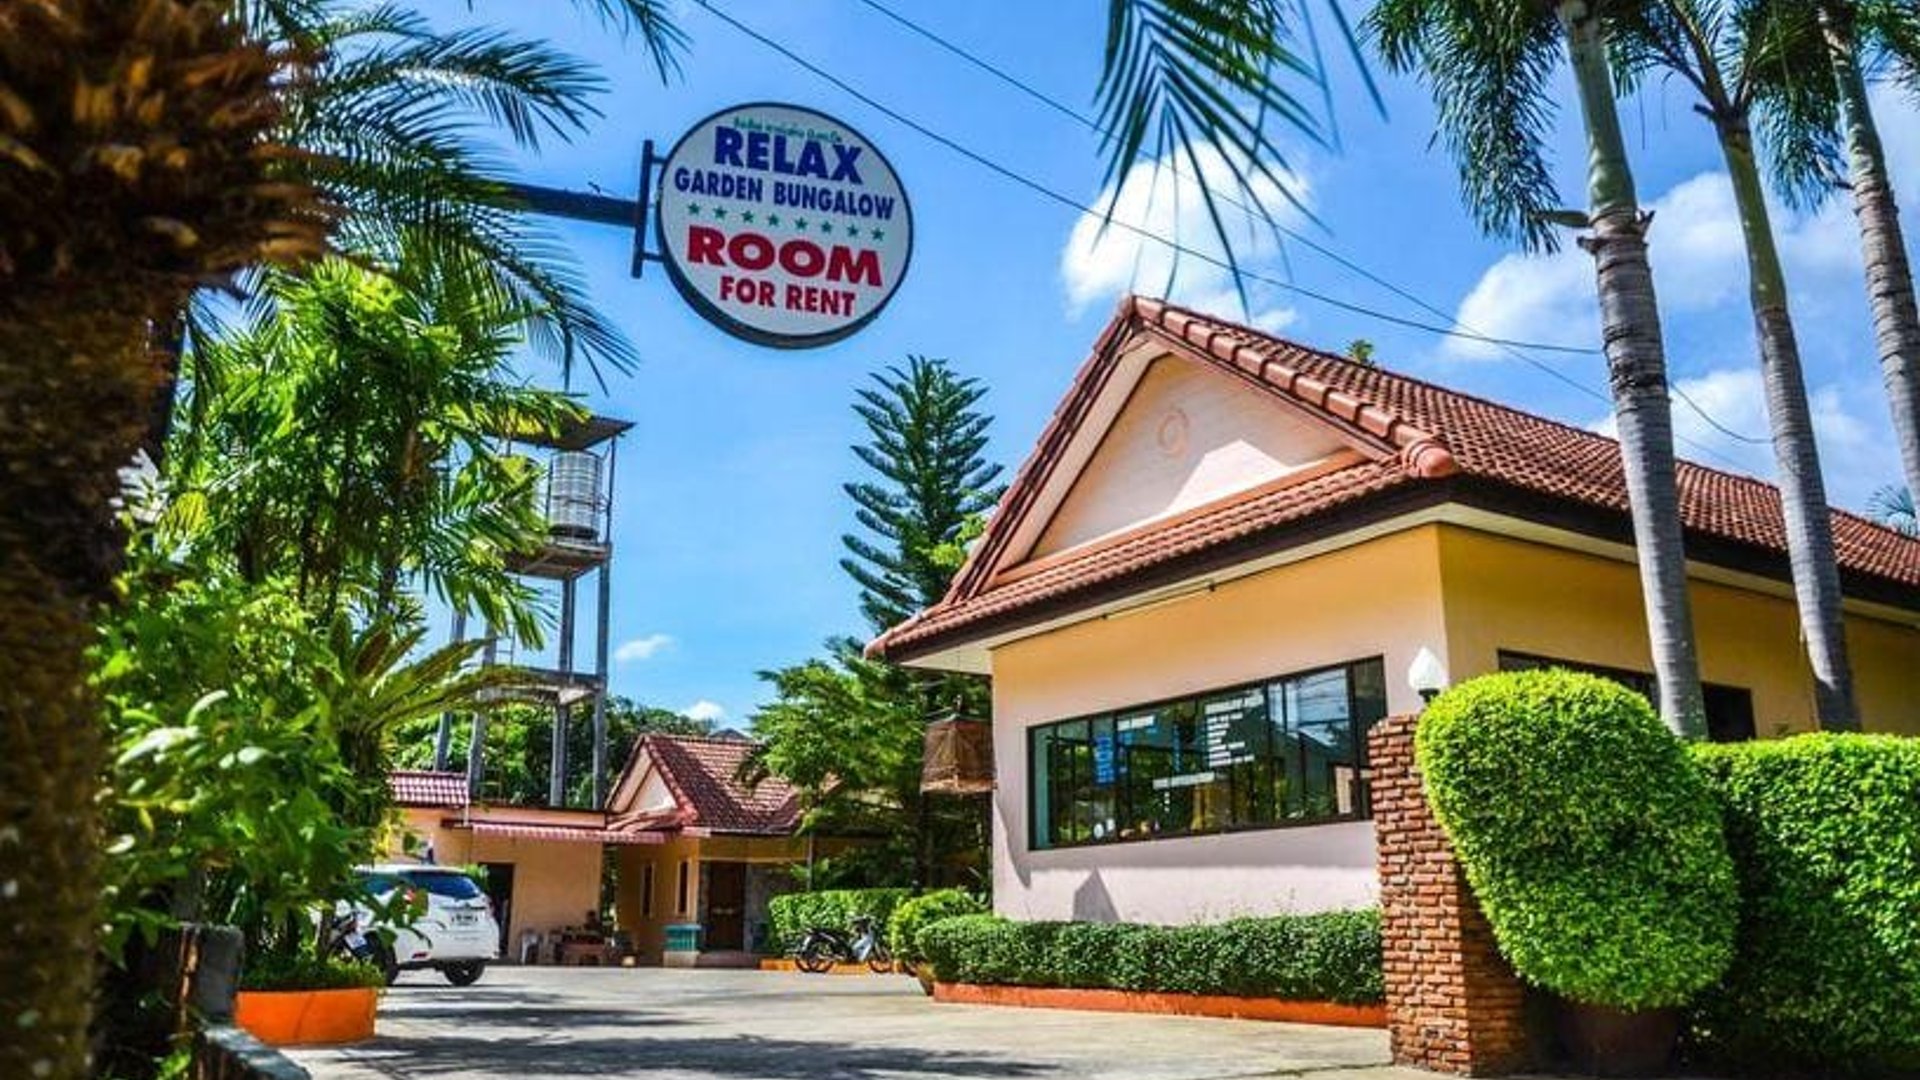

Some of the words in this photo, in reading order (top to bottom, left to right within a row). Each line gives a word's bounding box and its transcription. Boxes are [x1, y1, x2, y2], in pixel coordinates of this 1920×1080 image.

[714, 125, 863, 185] RELAX
[674, 166, 763, 202] GARDEN
[773, 181, 895, 220] BUNGALOW
[687, 225, 882, 287] ROOM
[720, 275, 776, 307] FOR
[785, 284, 856, 317] RENT
